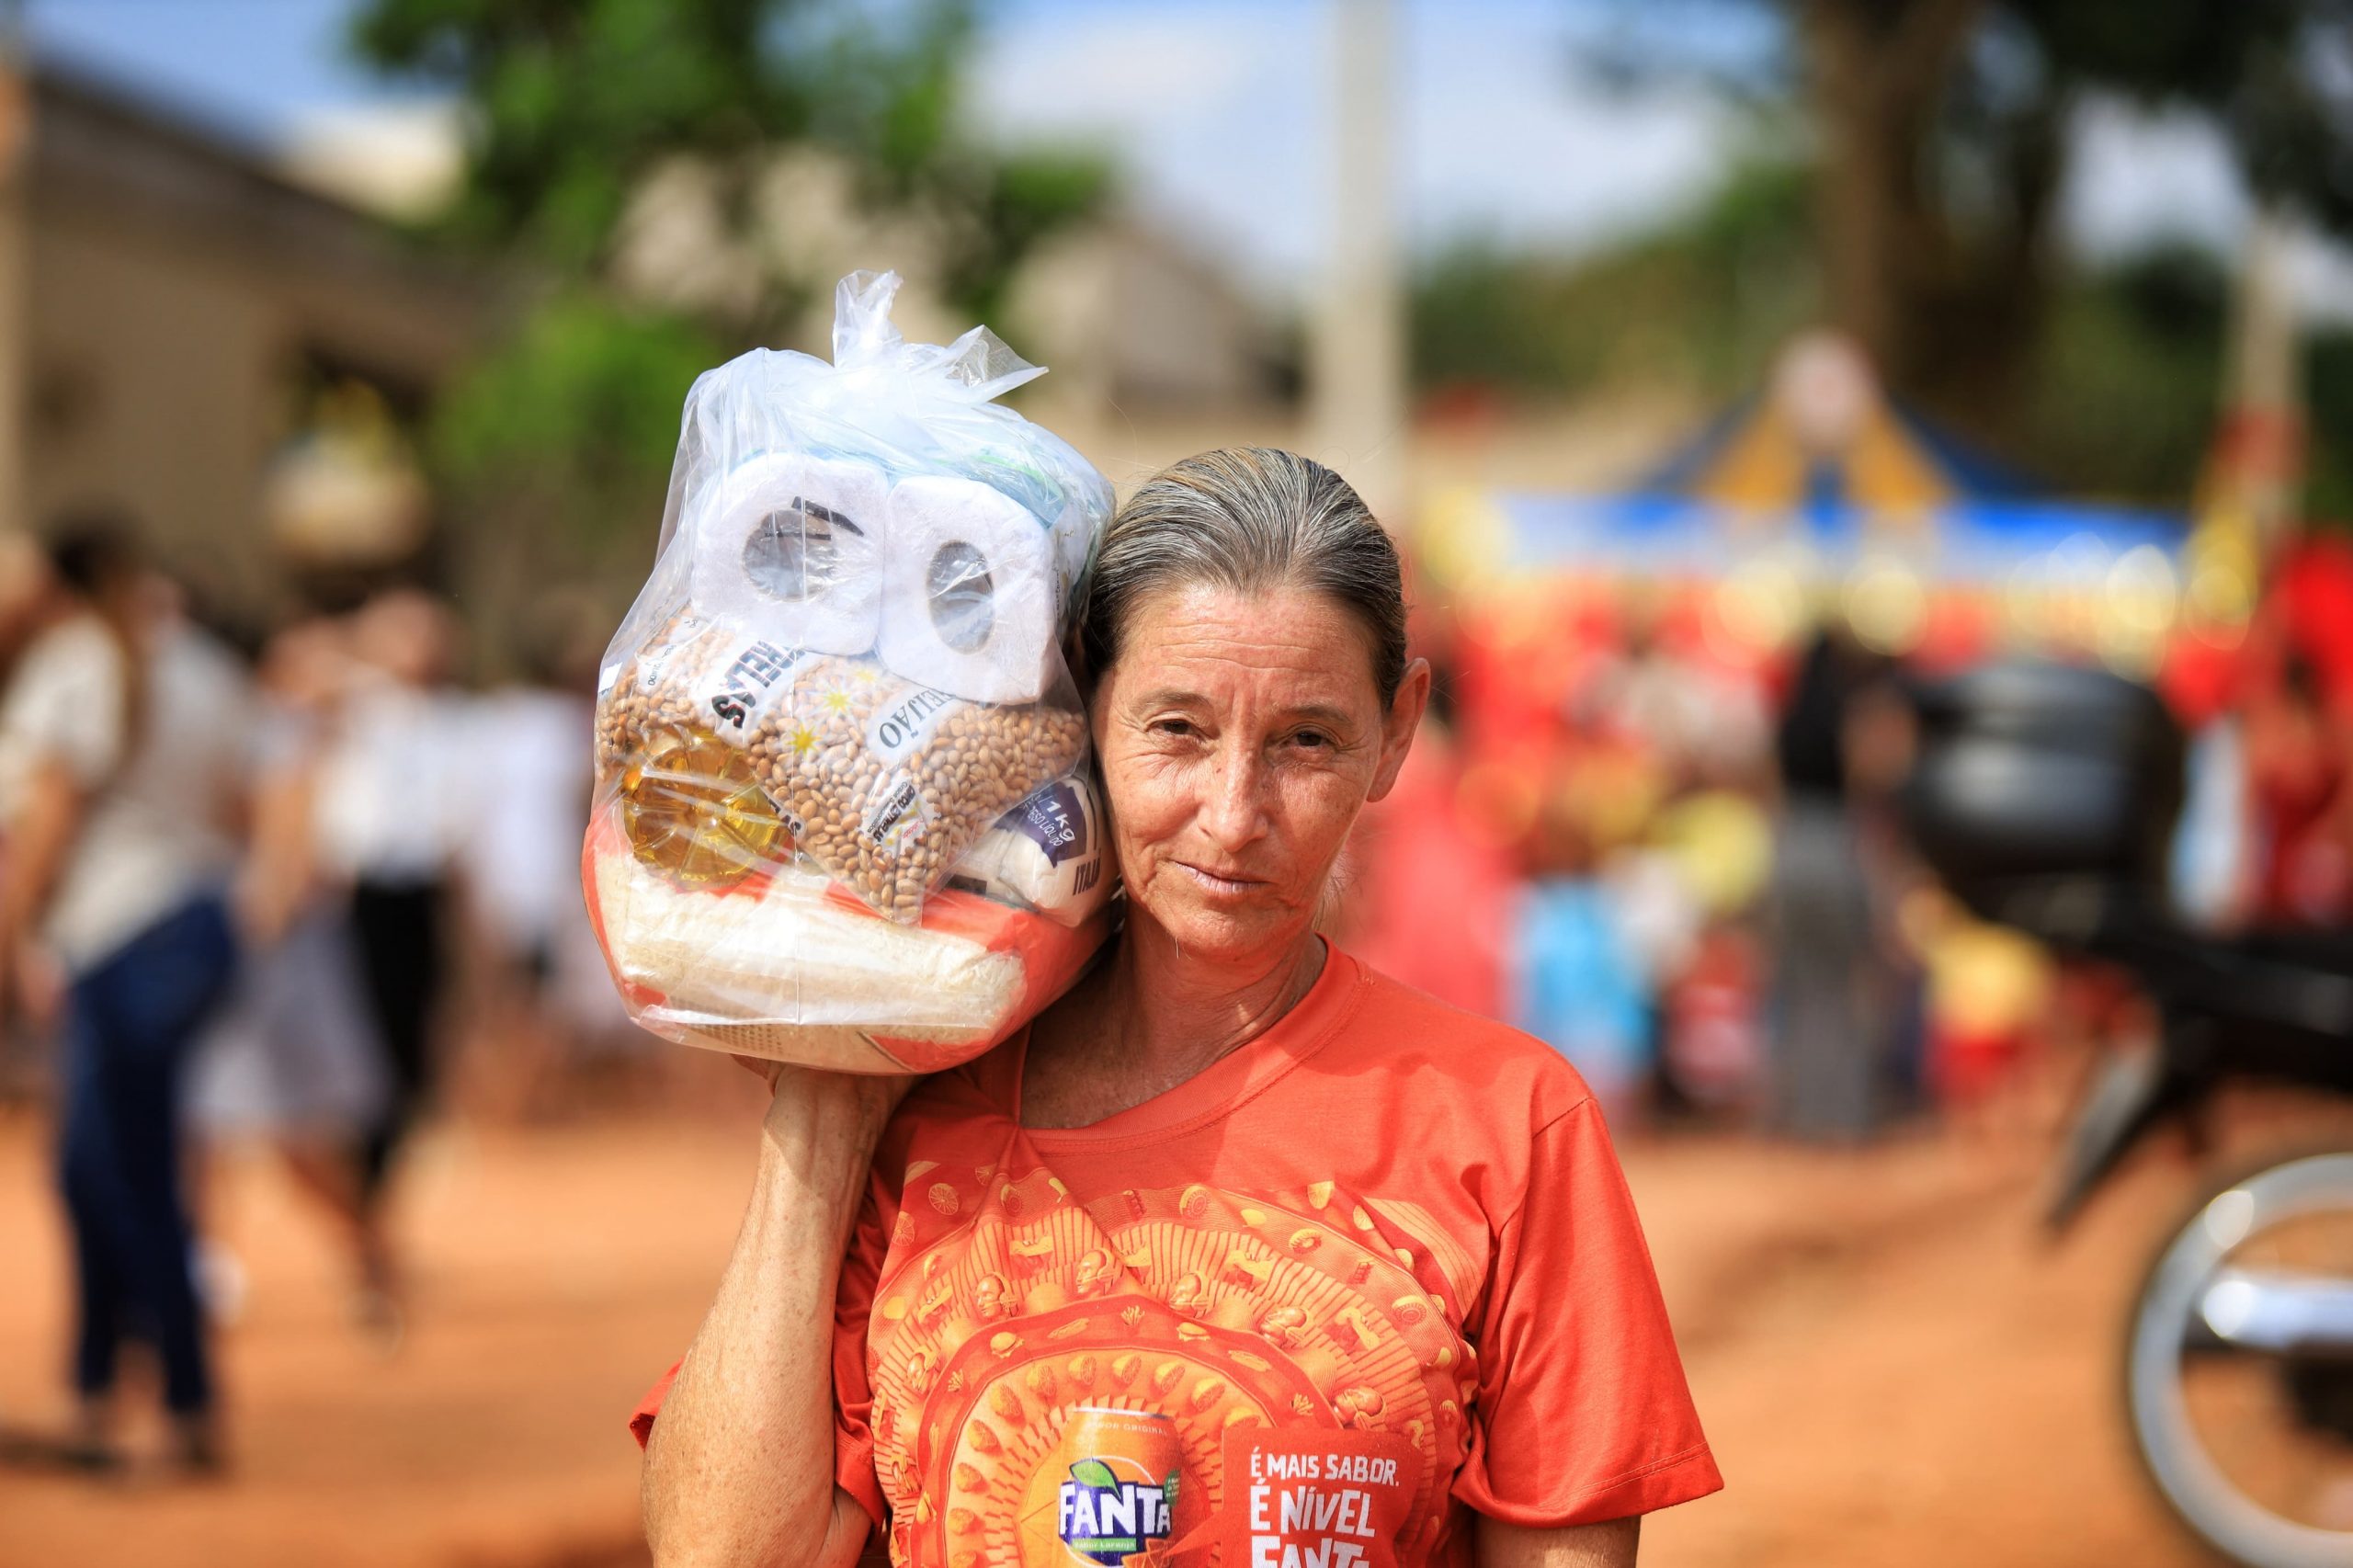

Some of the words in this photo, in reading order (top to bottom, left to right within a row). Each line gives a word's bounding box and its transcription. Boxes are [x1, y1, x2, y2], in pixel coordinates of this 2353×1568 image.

[1250, 1446, 1262, 1478] É
[1267, 1452, 1321, 1481] MAIS
[1324, 1453, 1400, 1487] SABOR.
[1059, 1483, 1172, 1536] FANTA
[1250, 1477, 1271, 1531] É
[1280, 1485, 1376, 1538] NÍVEL
[1251, 1535, 1370, 1568] FANT
